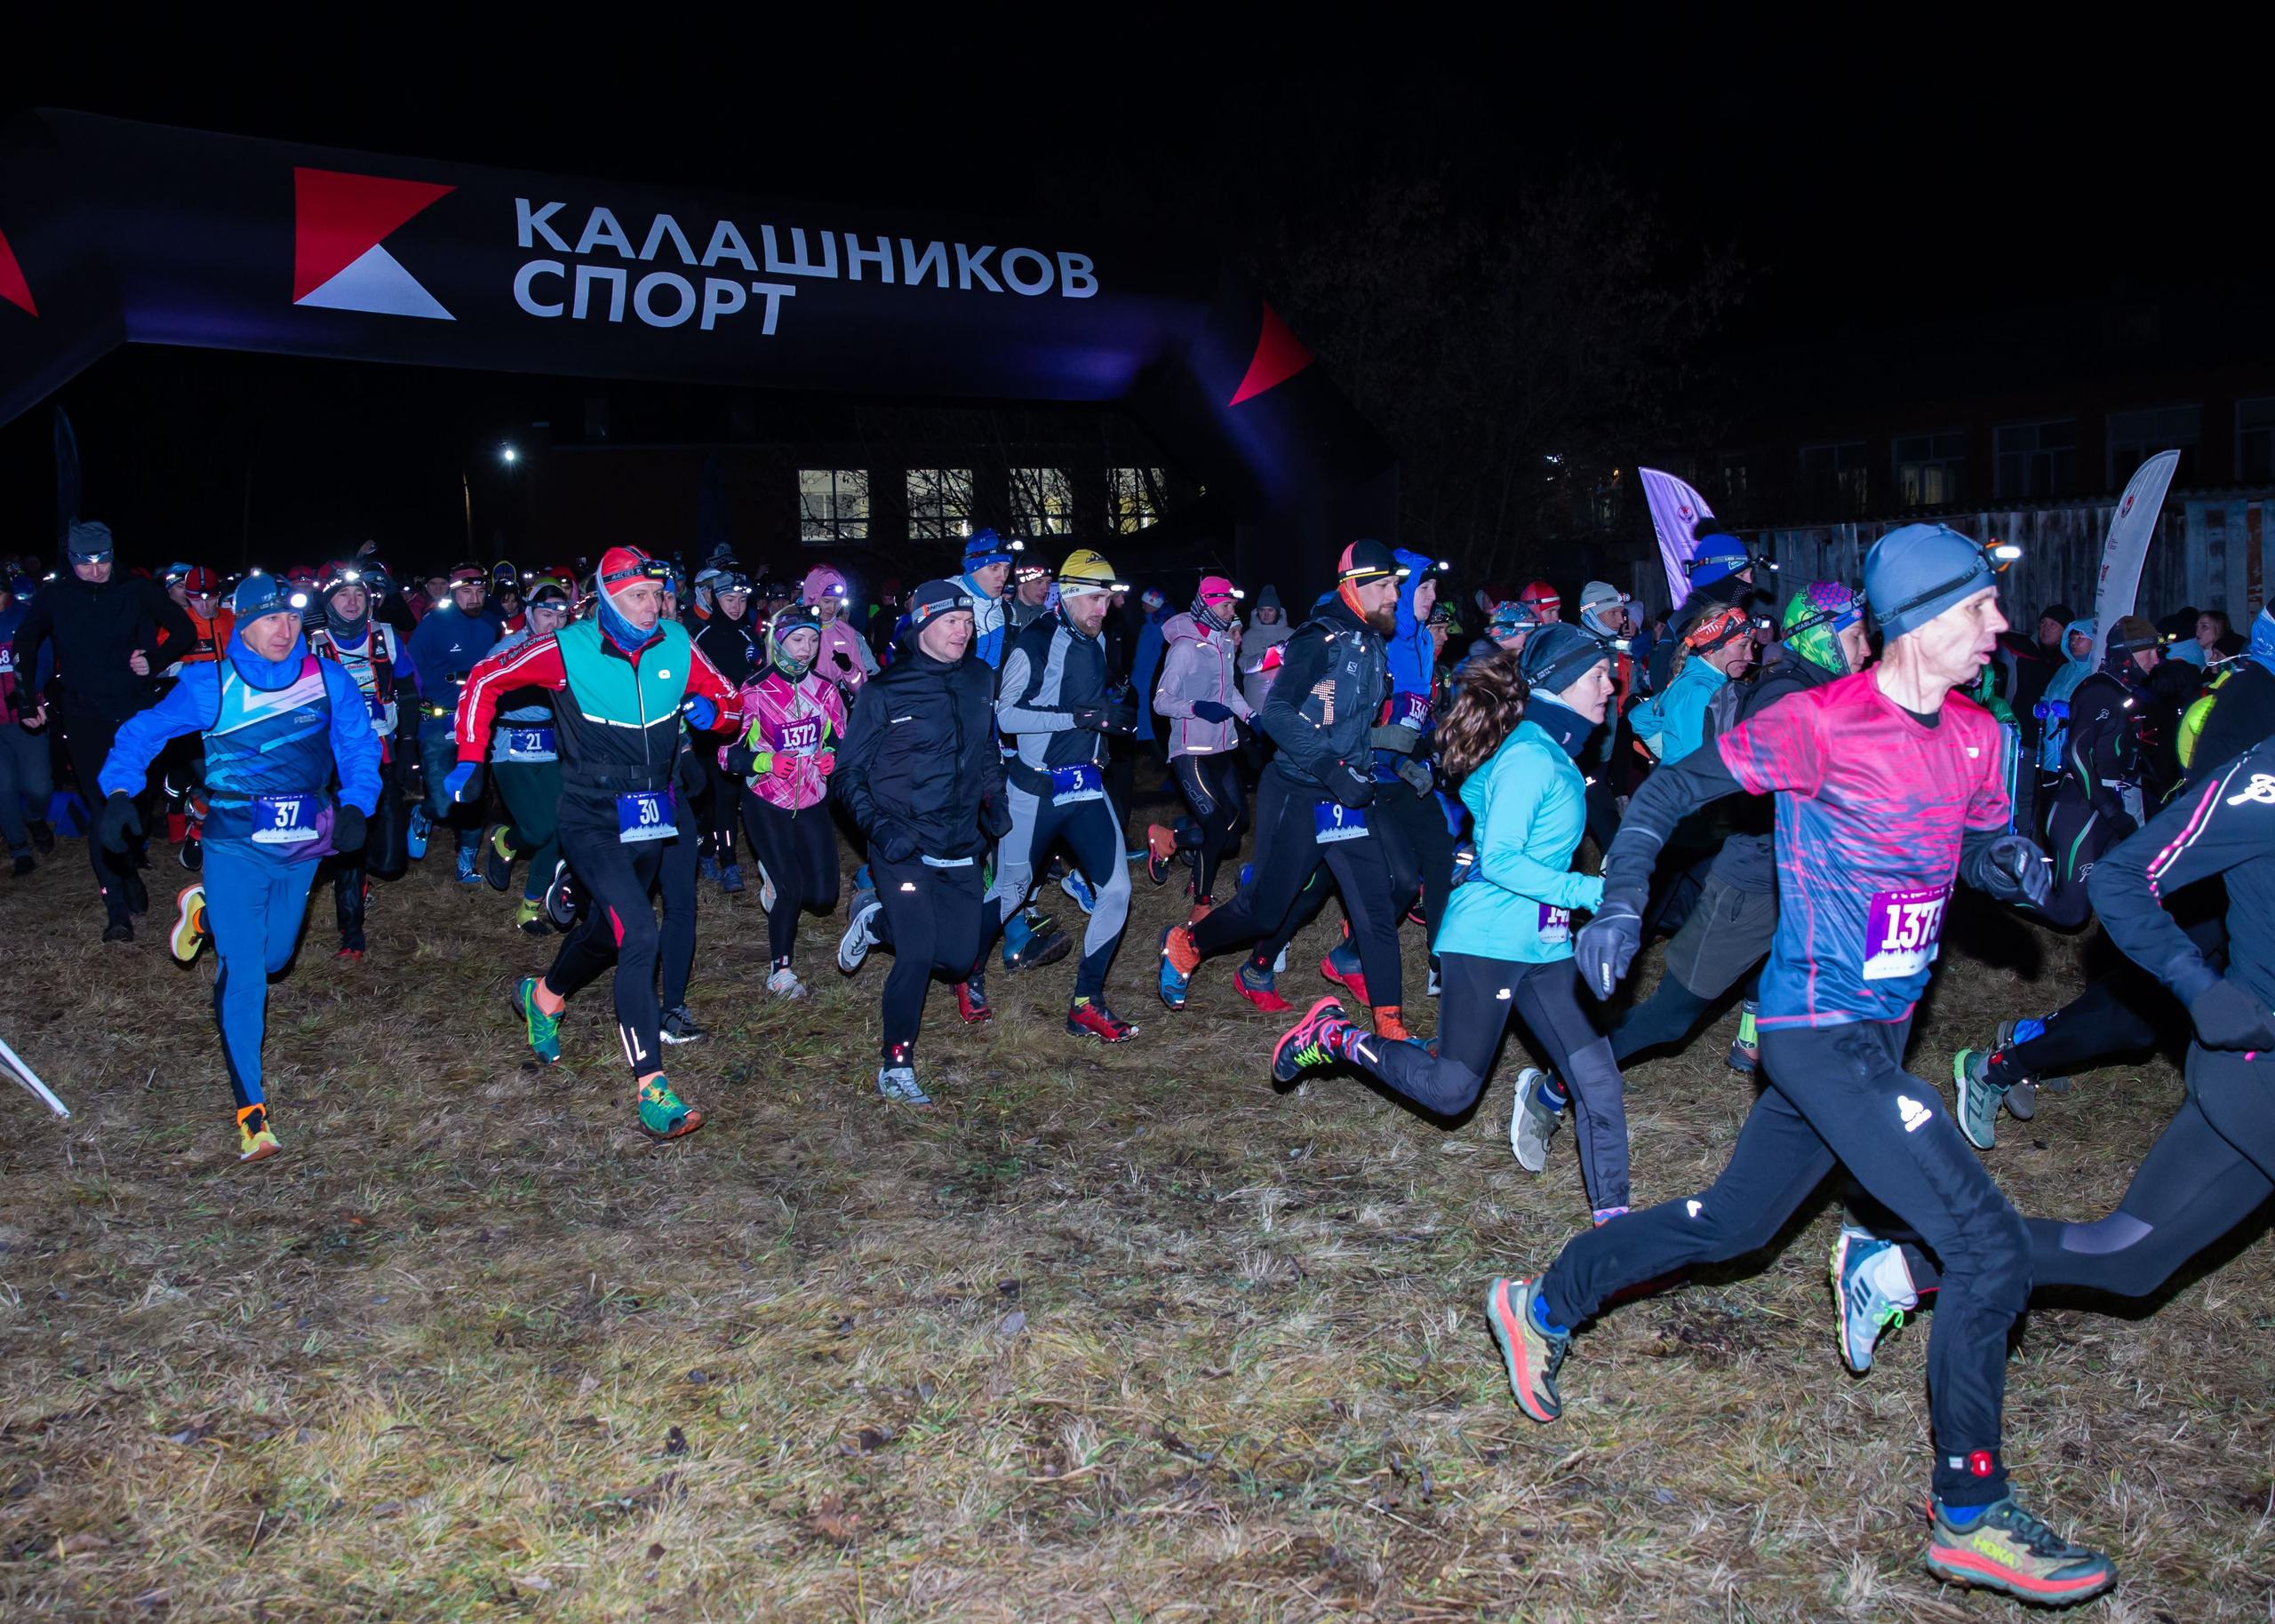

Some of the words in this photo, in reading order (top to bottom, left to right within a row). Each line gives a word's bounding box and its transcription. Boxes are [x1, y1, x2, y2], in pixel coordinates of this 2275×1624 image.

[515, 197, 1099, 299] КАЛАШНИКОВ
[513, 259, 796, 336] СПОРТ
[526, 733, 542, 751] 21
[782, 722, 818, 748] 1372
[1073, 769, 1084, 790] 3
[1182, 779, 1209, 815] odlo
[275, 800, 300, 827] 37
[638, 798, 660, 824] 30
[1333, 804, 1343, 826] 9
[1972, 1534, 2015, 1568] HOKA
